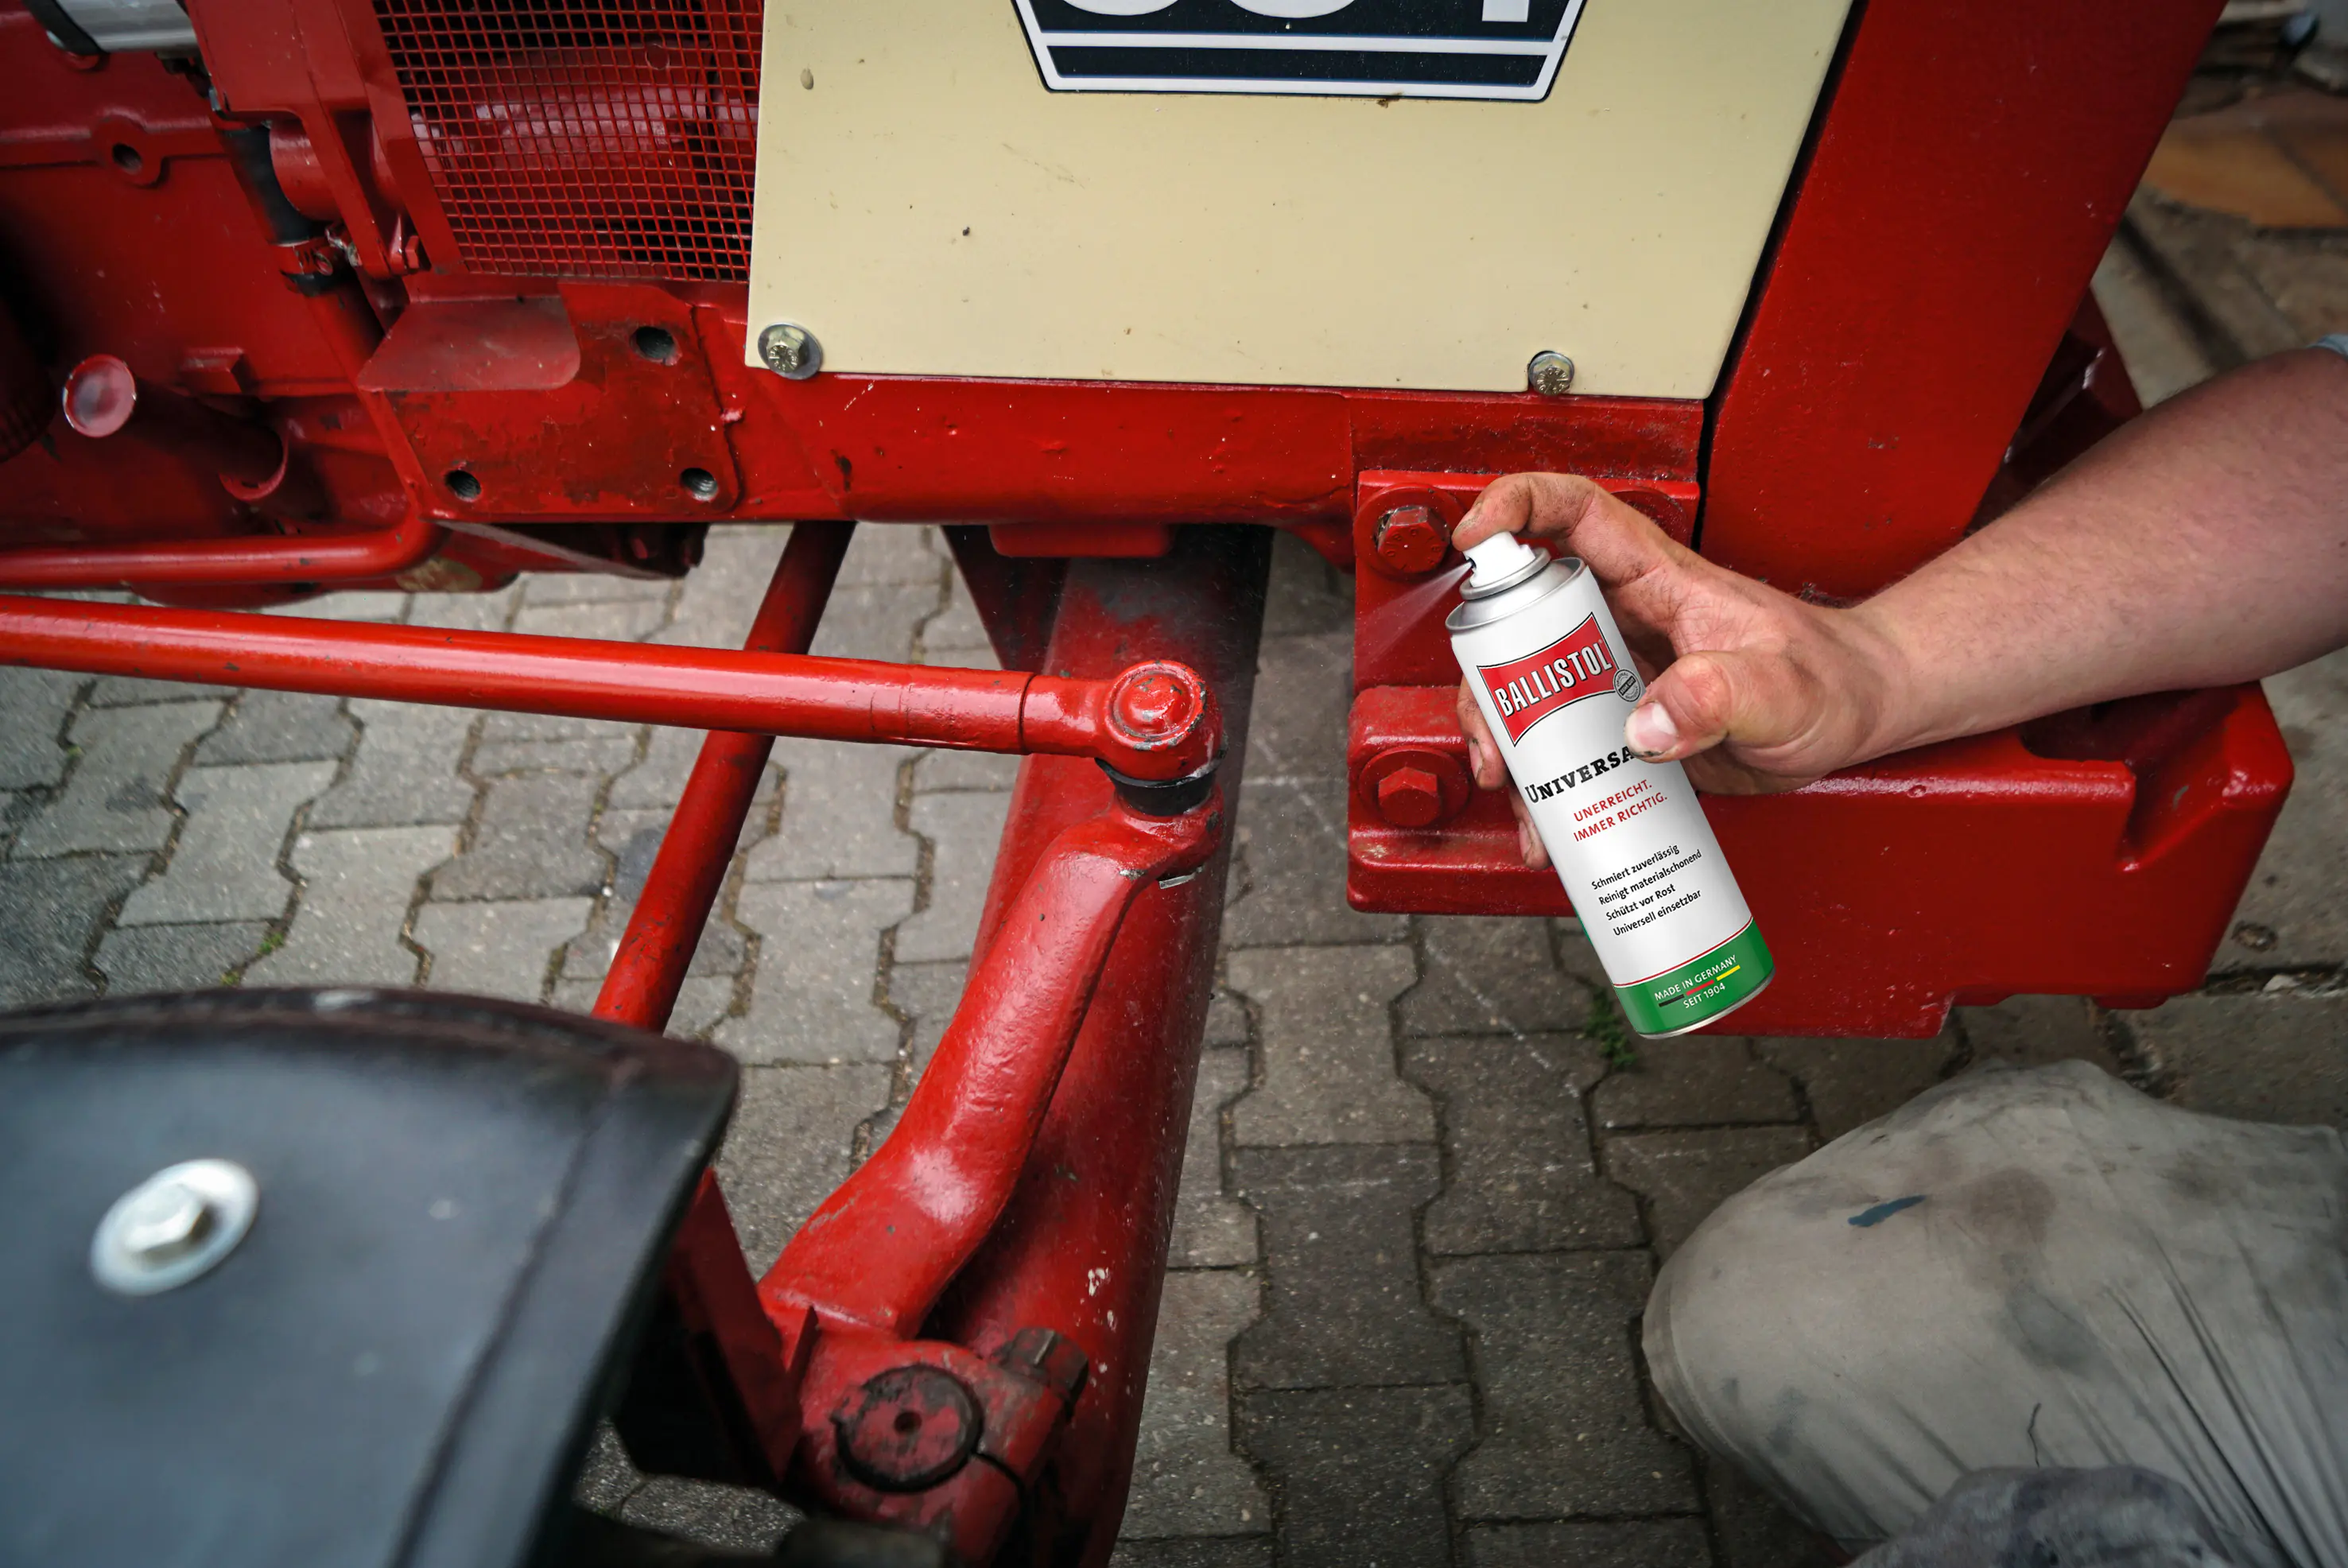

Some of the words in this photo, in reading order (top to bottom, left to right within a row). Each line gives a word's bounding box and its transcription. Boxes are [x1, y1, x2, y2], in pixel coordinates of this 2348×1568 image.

[1494, 642, 1613, 717] BALLISTOL
[1524, 746, 1635, 803] UNIVERSA
[1574, 779, 1652, 822] UNERREICHT.
[1574, 816, 1616, 841] IMMER
[1616, 792, 1667, 822] RICHTIG.
[1591, 867, 1631, 890] Schmiert
[1631, 844, 1679, 873] zuverlässig
[1598, 887, 1629, 905] Reinigt
[1630, 849, 1702, 892] materialschonend
[1606, 902, 1639, 921] Schützt
[1639, 895, 1654, 906] vor
[1655, 883, 1675, 899] Rost
[1613, 911, 1656, 936] Universell
[1657, 890, 1702, 918] einsetzbar
[1654, 984, 1681, 1000] MADE
[1682, 978, 1694, 989] IN
[1694, 954, 1737, 983] GERMANY
[1683, 993, 1702, 1008] SEIT
[1703, 982, 1725, 999] 1904
